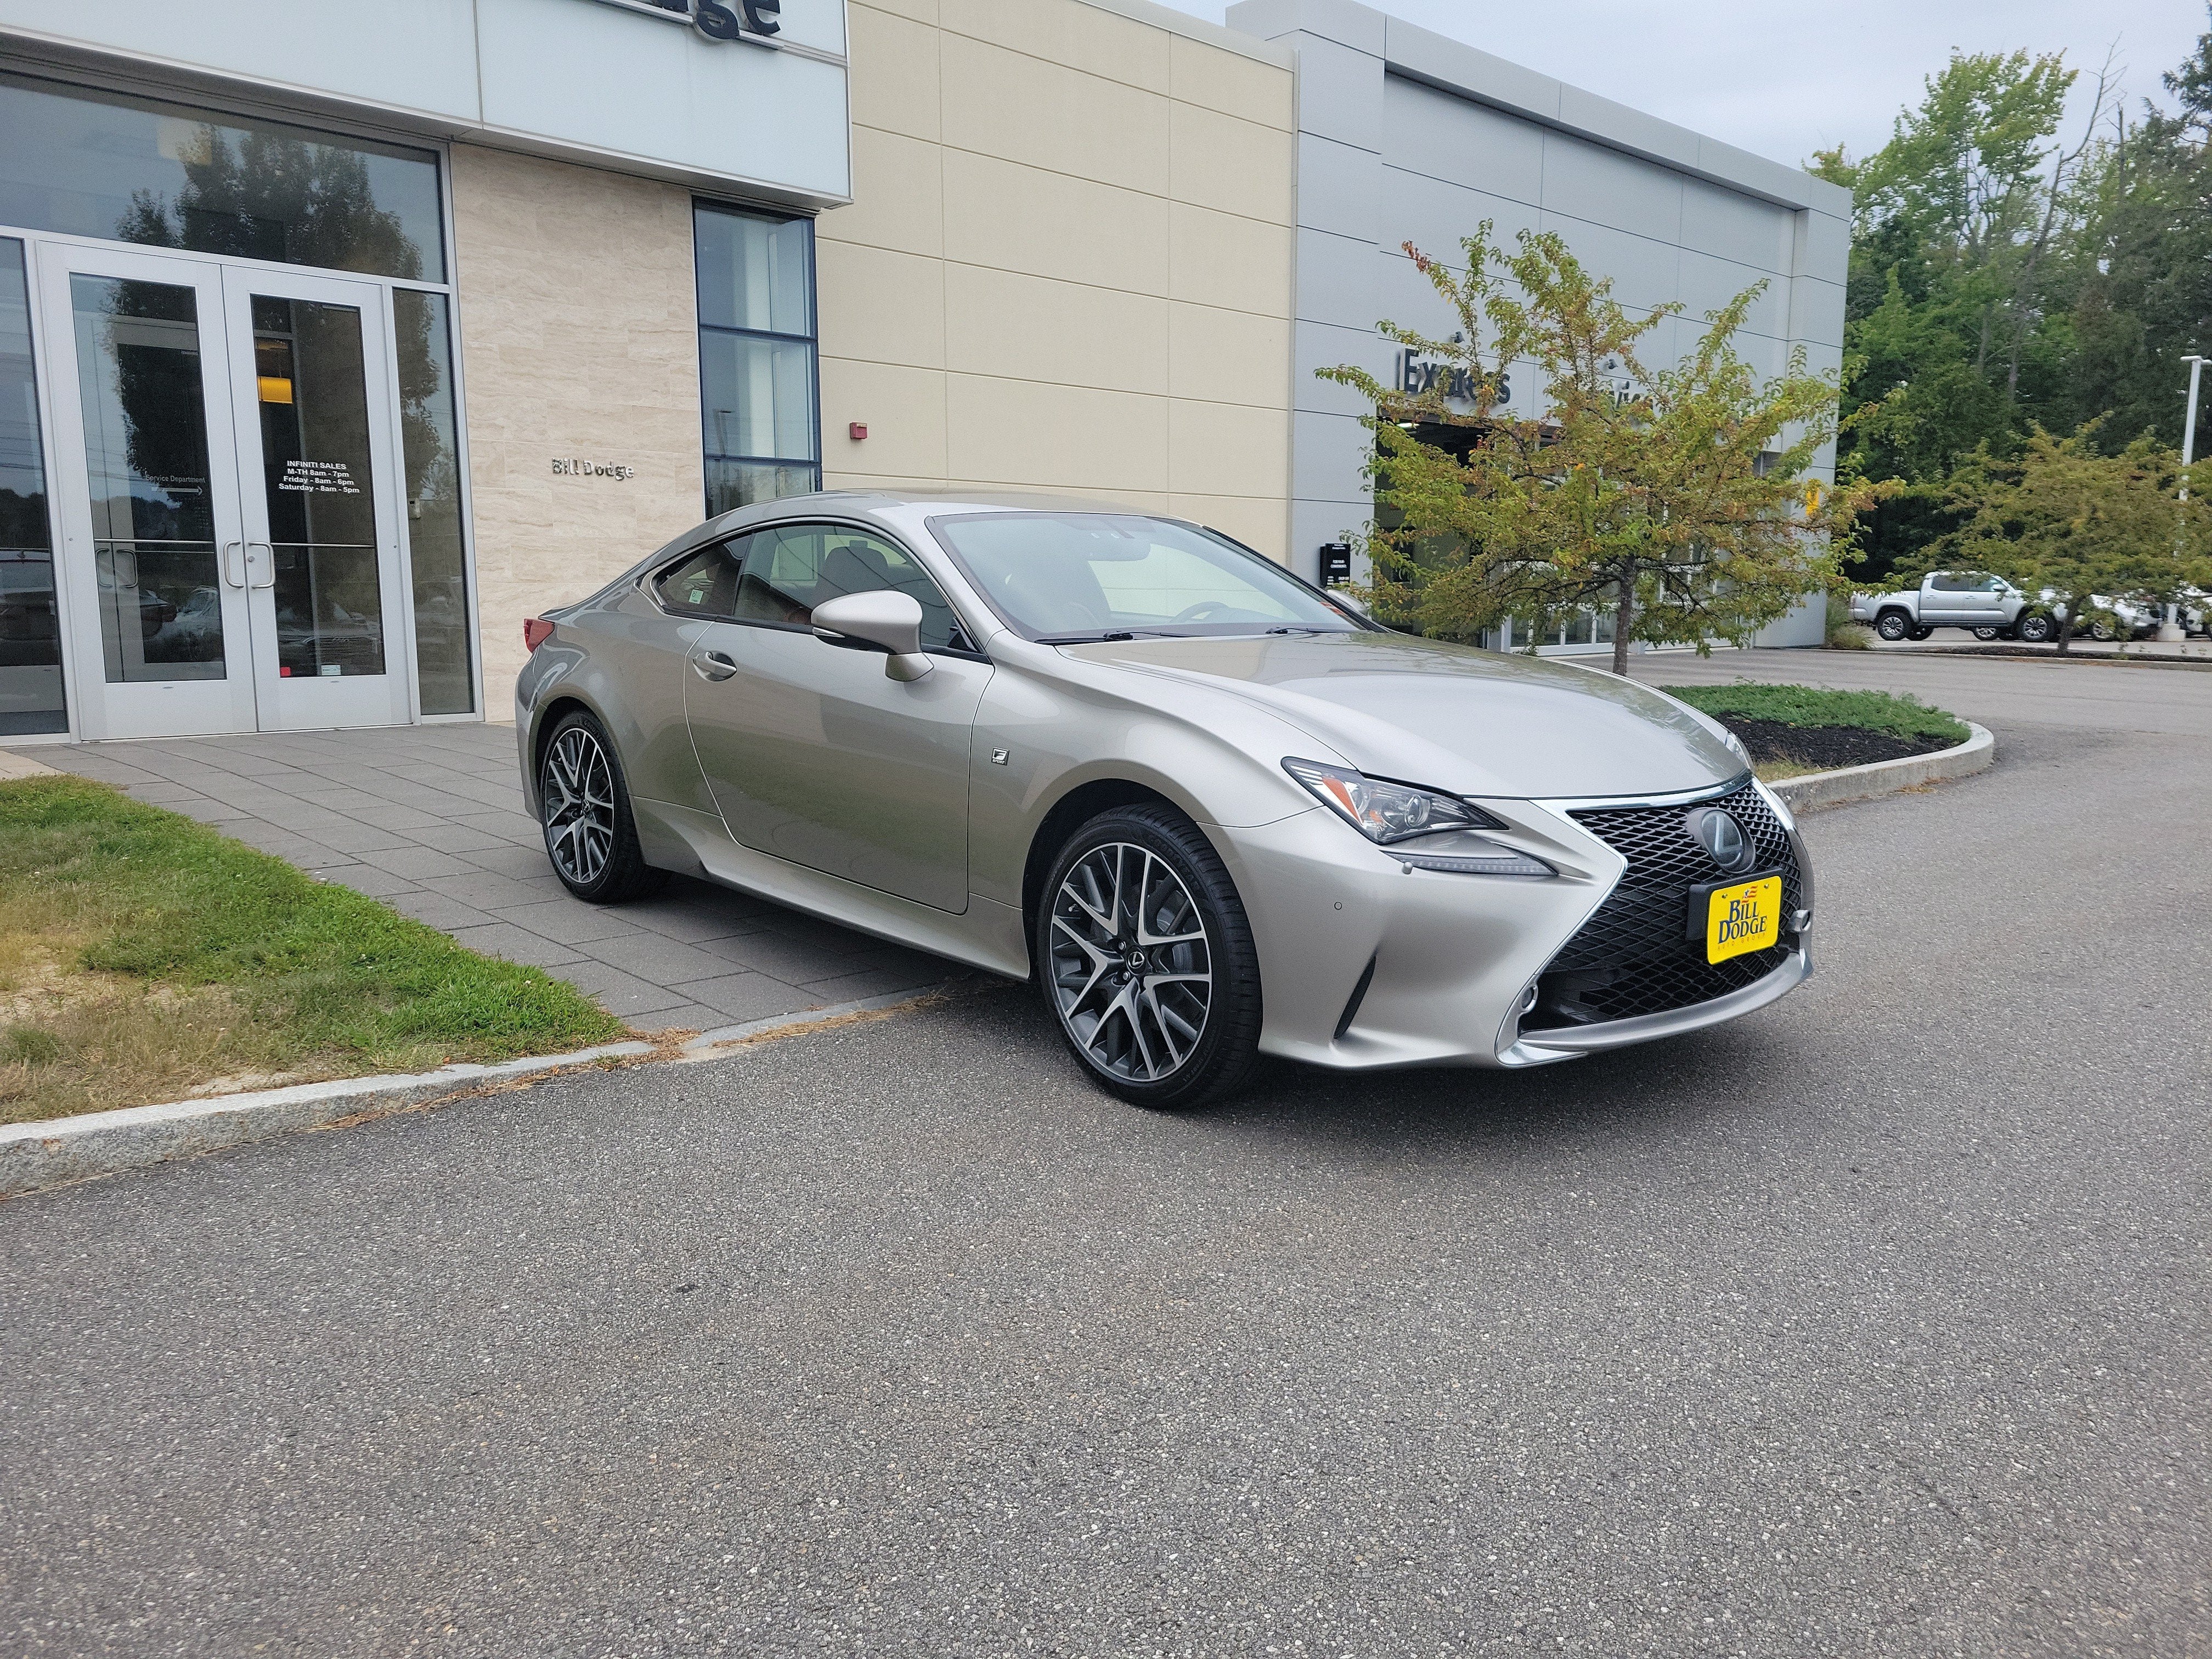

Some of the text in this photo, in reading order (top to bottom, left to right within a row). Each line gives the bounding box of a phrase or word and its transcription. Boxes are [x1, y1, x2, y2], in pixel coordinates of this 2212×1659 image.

[552, 458, 634, 481] Bill Dodge
[146, 474, 169, 482] Service
[283, 476, 308, 484] Friday
[278, 483, 313, 492] Saturday
[1729, 899, 1760, 923] BILL
[1718, 915, 1767, 944] DODGE
